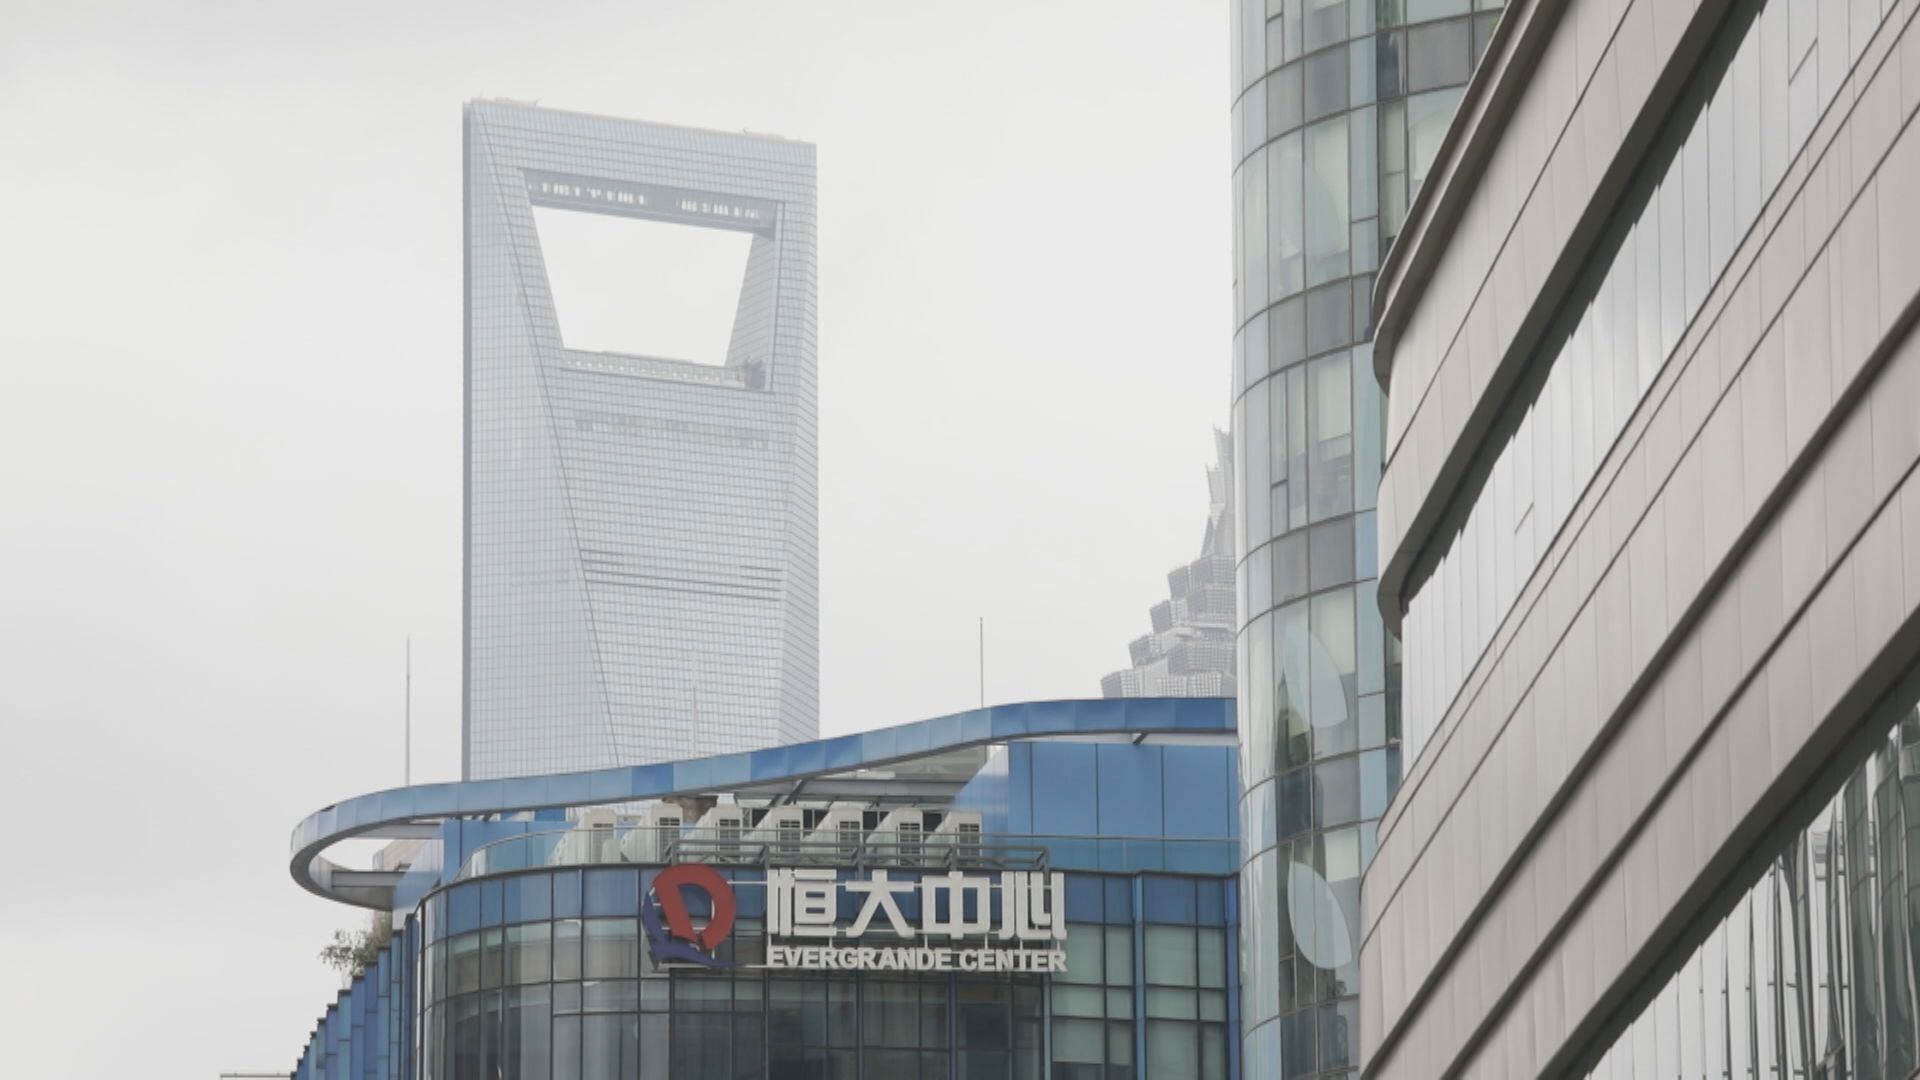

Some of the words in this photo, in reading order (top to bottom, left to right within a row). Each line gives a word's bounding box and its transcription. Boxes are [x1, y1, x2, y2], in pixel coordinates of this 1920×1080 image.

[767, 868, 1067, 940] 恒大中心
[767, 946, 953, 970] EVERGRANDE
[959, 948, 1067, 972] CENTER
